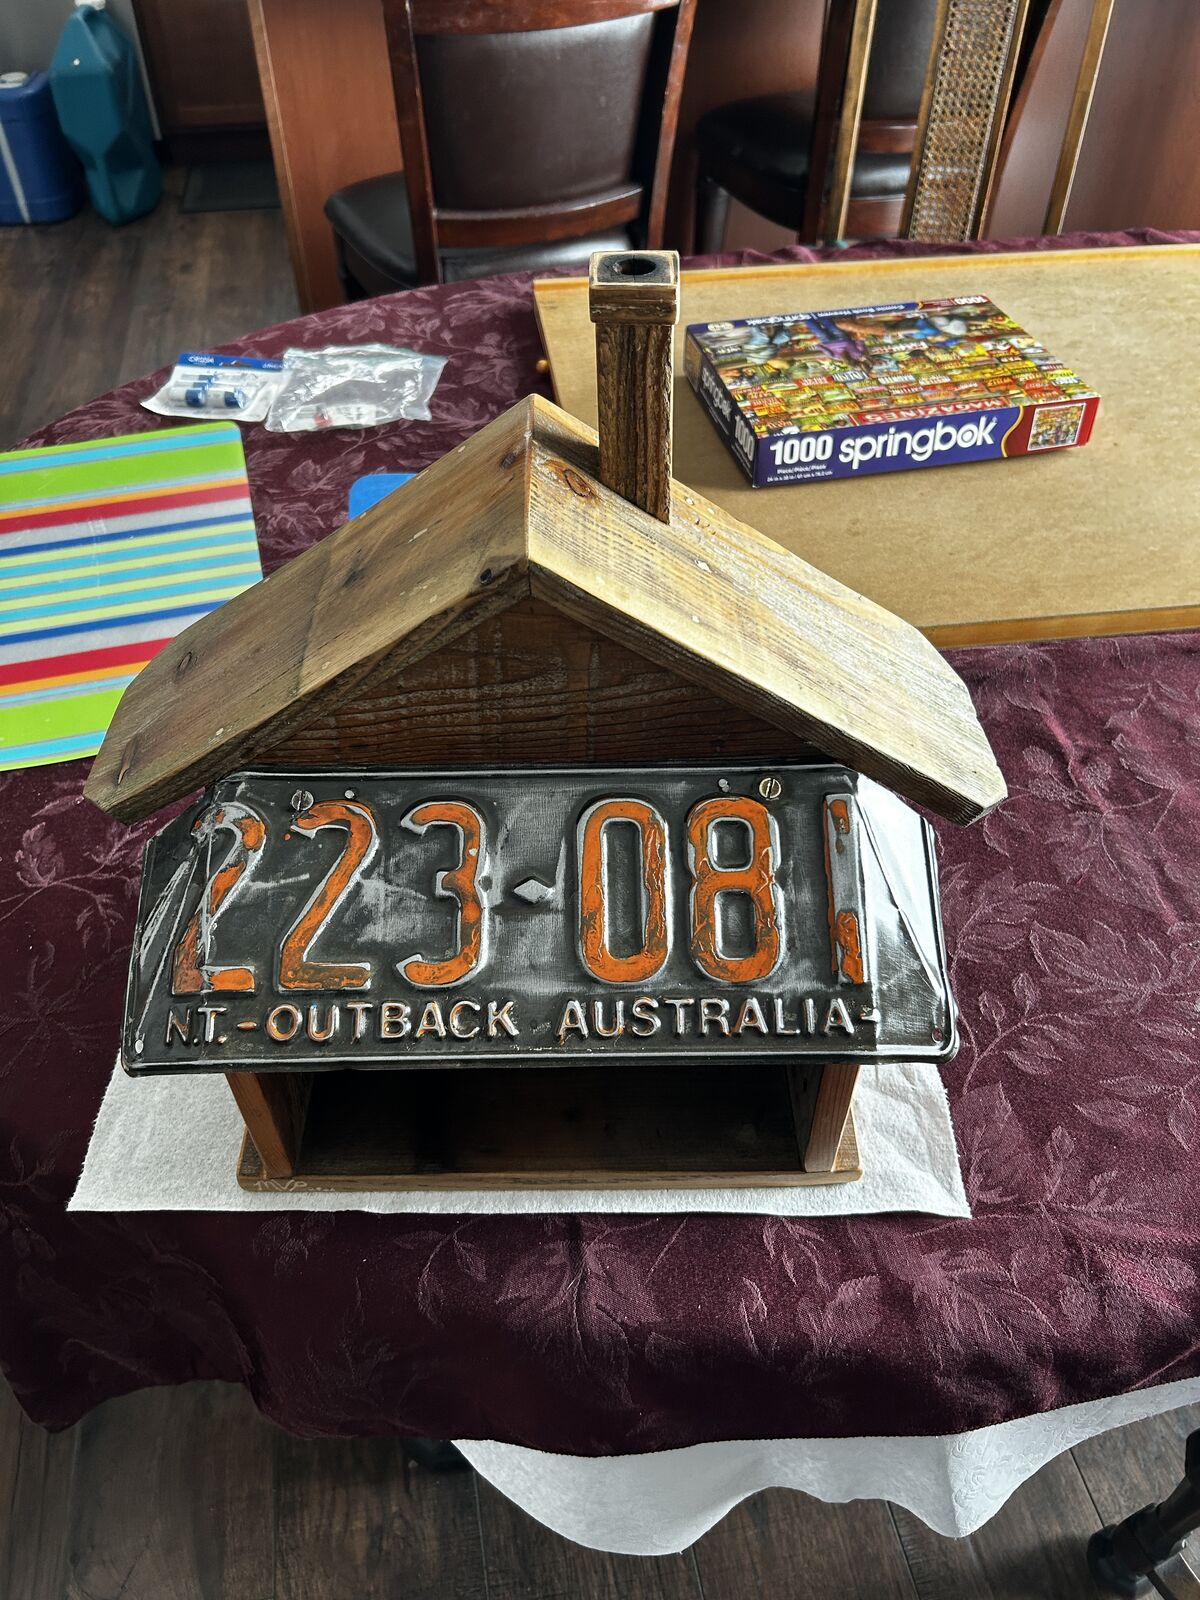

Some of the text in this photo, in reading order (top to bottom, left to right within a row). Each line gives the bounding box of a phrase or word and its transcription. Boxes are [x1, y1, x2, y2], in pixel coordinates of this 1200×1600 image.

[865, 398, 1002, 422] MAGAZINES
[769, 433, 834, 466] 1000
[838, 416, 995, 470] springbok
